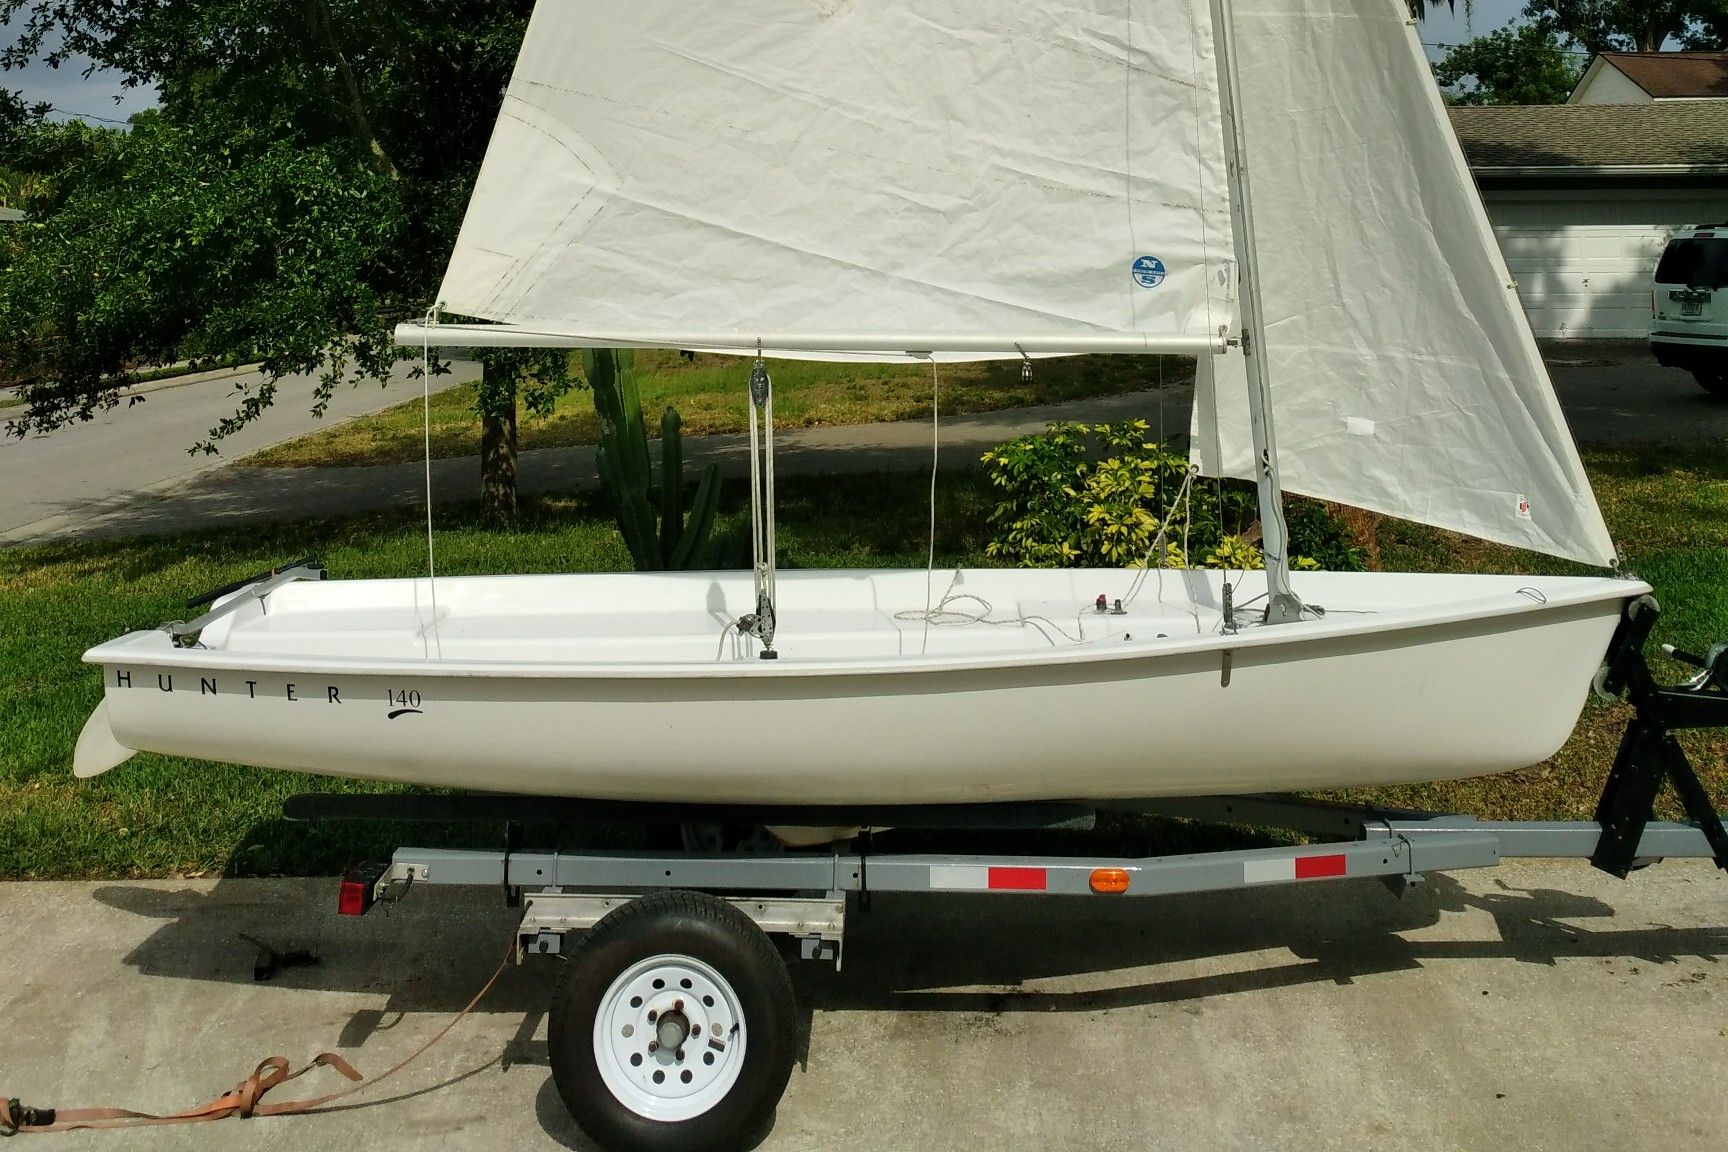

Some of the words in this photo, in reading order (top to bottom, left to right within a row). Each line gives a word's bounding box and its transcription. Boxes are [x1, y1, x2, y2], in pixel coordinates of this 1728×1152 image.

[1140, 259, 1158, 268] N
[1141, 275, 1156, 284] S
[116, 670, 342, 705] HUNTER
[387, 689, 421, 708] 140
